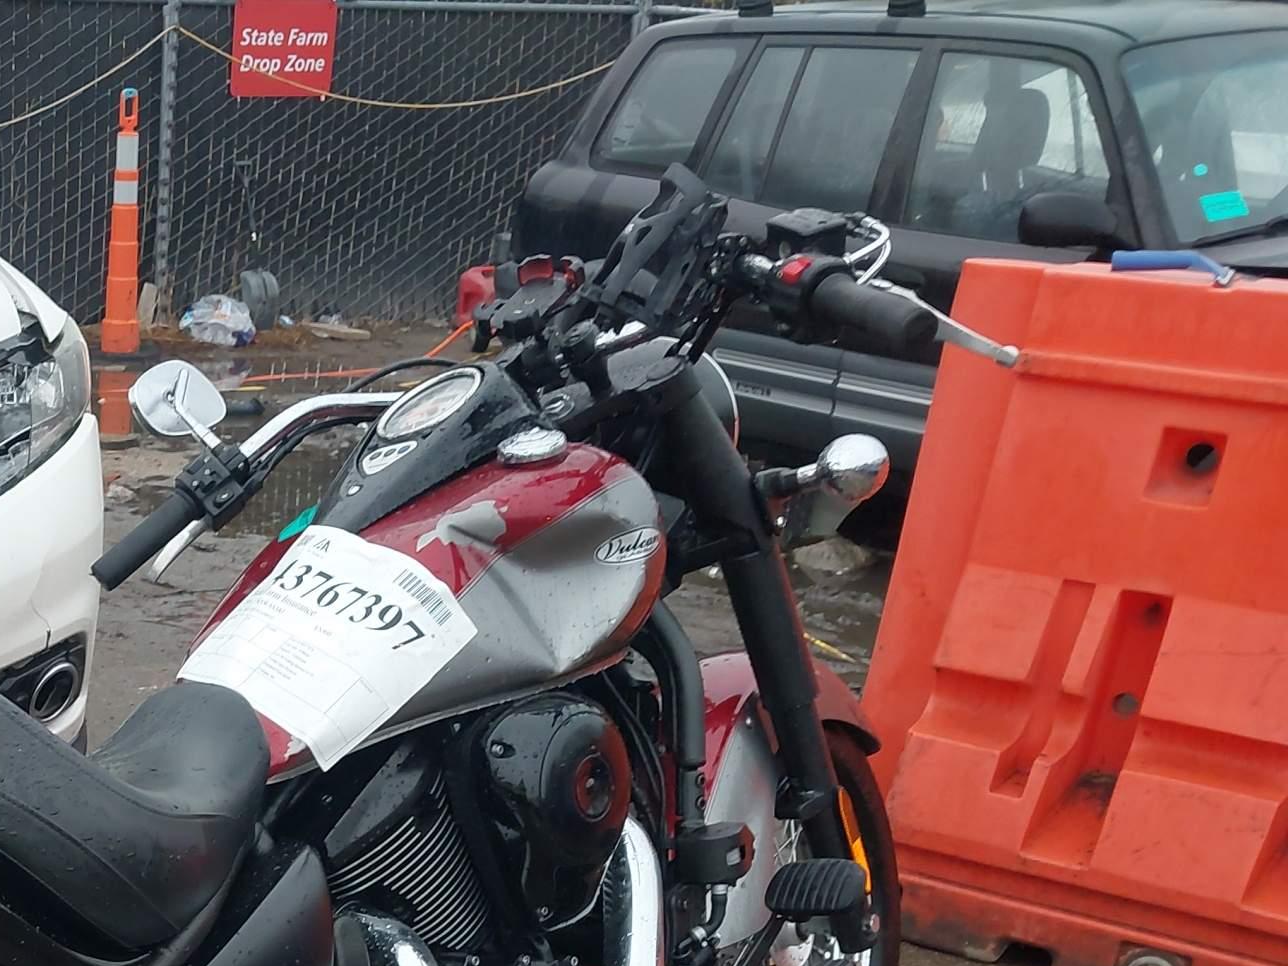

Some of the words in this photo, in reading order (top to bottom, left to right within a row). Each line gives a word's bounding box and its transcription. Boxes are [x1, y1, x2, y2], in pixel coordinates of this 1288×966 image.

[240, 28, 283, 47] State
[288, 28, 328, 47] Farm
[240, 55, 281, 75] Drop
[284, 56, 326, 72] Zone
